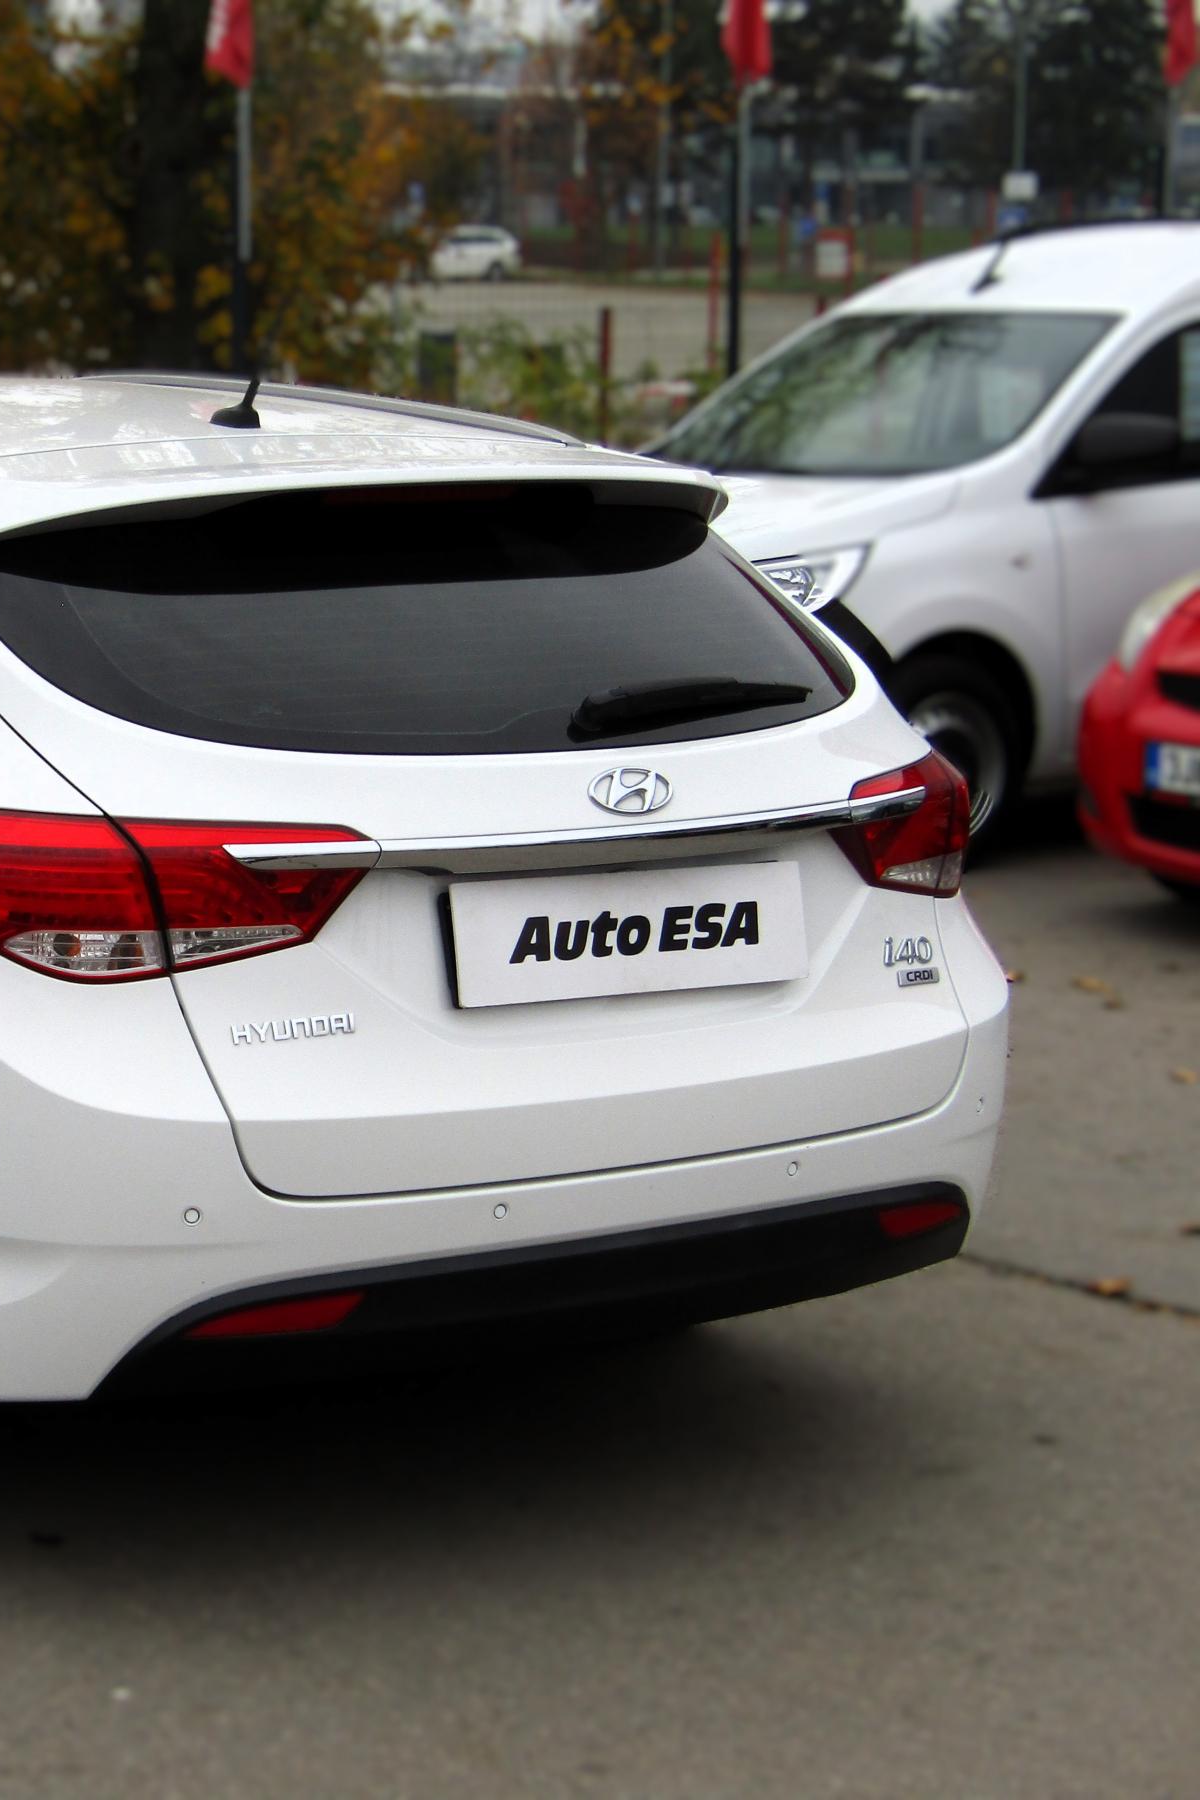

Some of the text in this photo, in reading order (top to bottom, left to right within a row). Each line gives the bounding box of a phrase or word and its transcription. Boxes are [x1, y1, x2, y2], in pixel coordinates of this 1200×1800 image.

[509, 901, 759, 964] Auto ESA
[883, 936, 932, 967] i40
[231, 1012, 355, 1045] HYUNDAI
